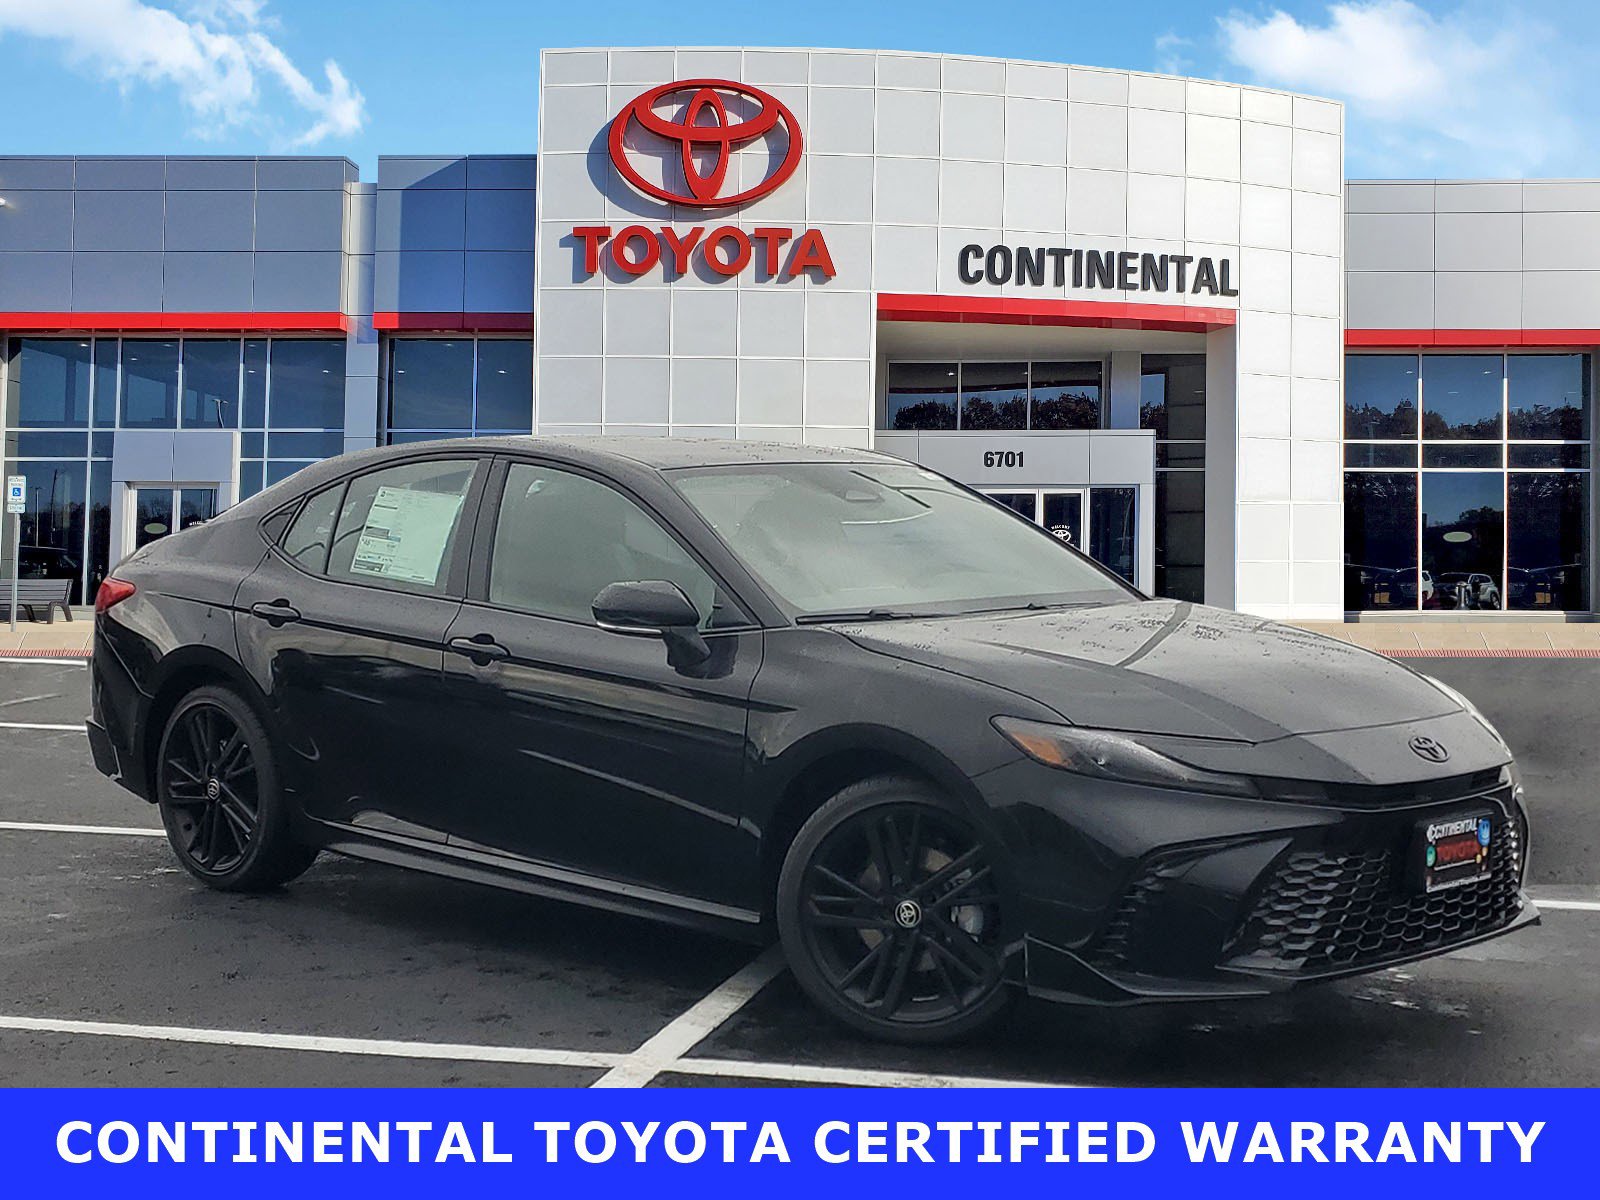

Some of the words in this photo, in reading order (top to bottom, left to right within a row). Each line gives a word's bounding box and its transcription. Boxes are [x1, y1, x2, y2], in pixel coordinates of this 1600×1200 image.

[572, 225, 837, 277] TOYOTA
[958, 244, 1239, 296] CONTINENTAL
[983, 451, 1024, 468] 6701
